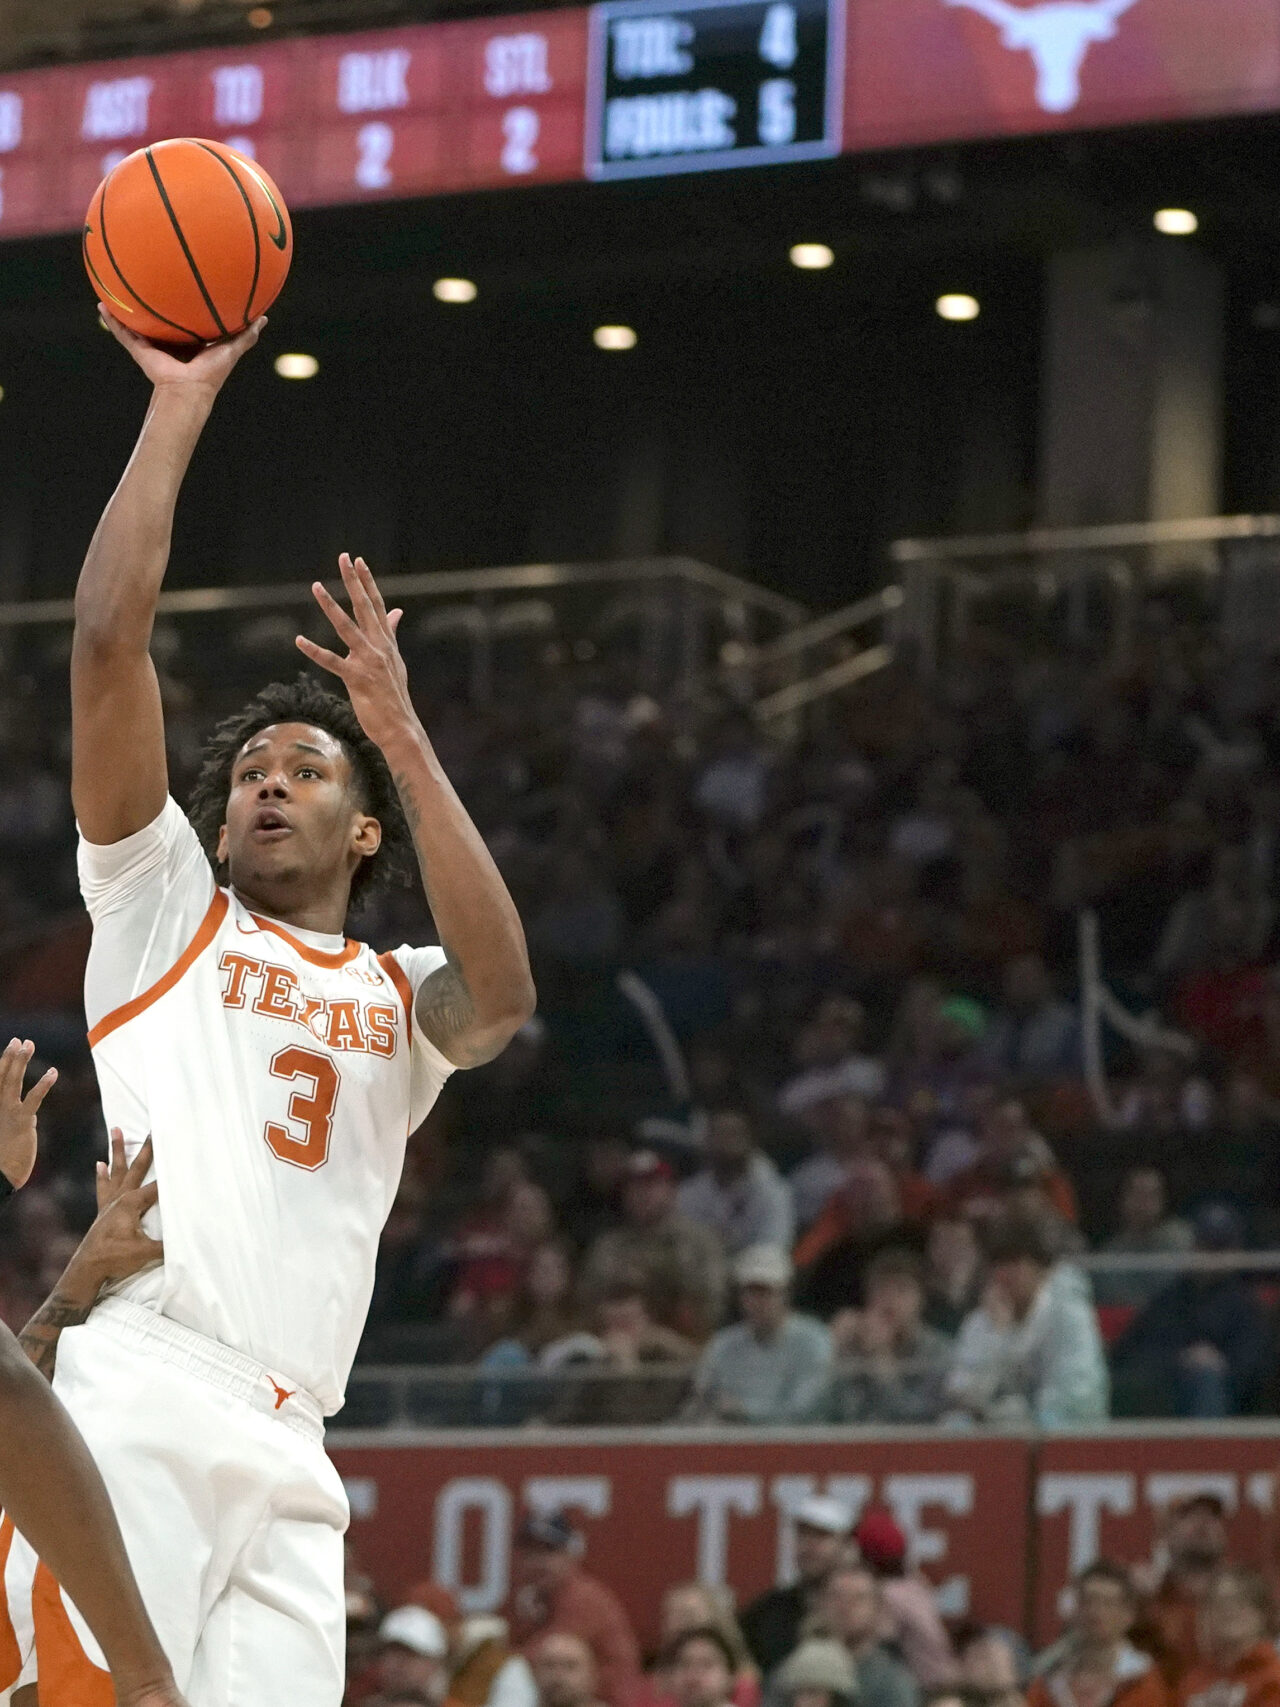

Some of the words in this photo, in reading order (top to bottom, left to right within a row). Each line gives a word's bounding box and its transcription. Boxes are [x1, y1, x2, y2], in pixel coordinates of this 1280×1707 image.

[759, 4, 797, 69] 4
[83, 76, 152, 140] AST
[213, 64, 265, 126] TO
[337, 48, 411, 112] BLK
[485, 33, 553, 97] STL
[758, 78, 796, 146] 5
[355, 121, 394, 188] 2
[501, 106, 539, 174] 2
[219, 951, 398, 1060] TEXAS
[264, 1044, 341, 1172] 3
